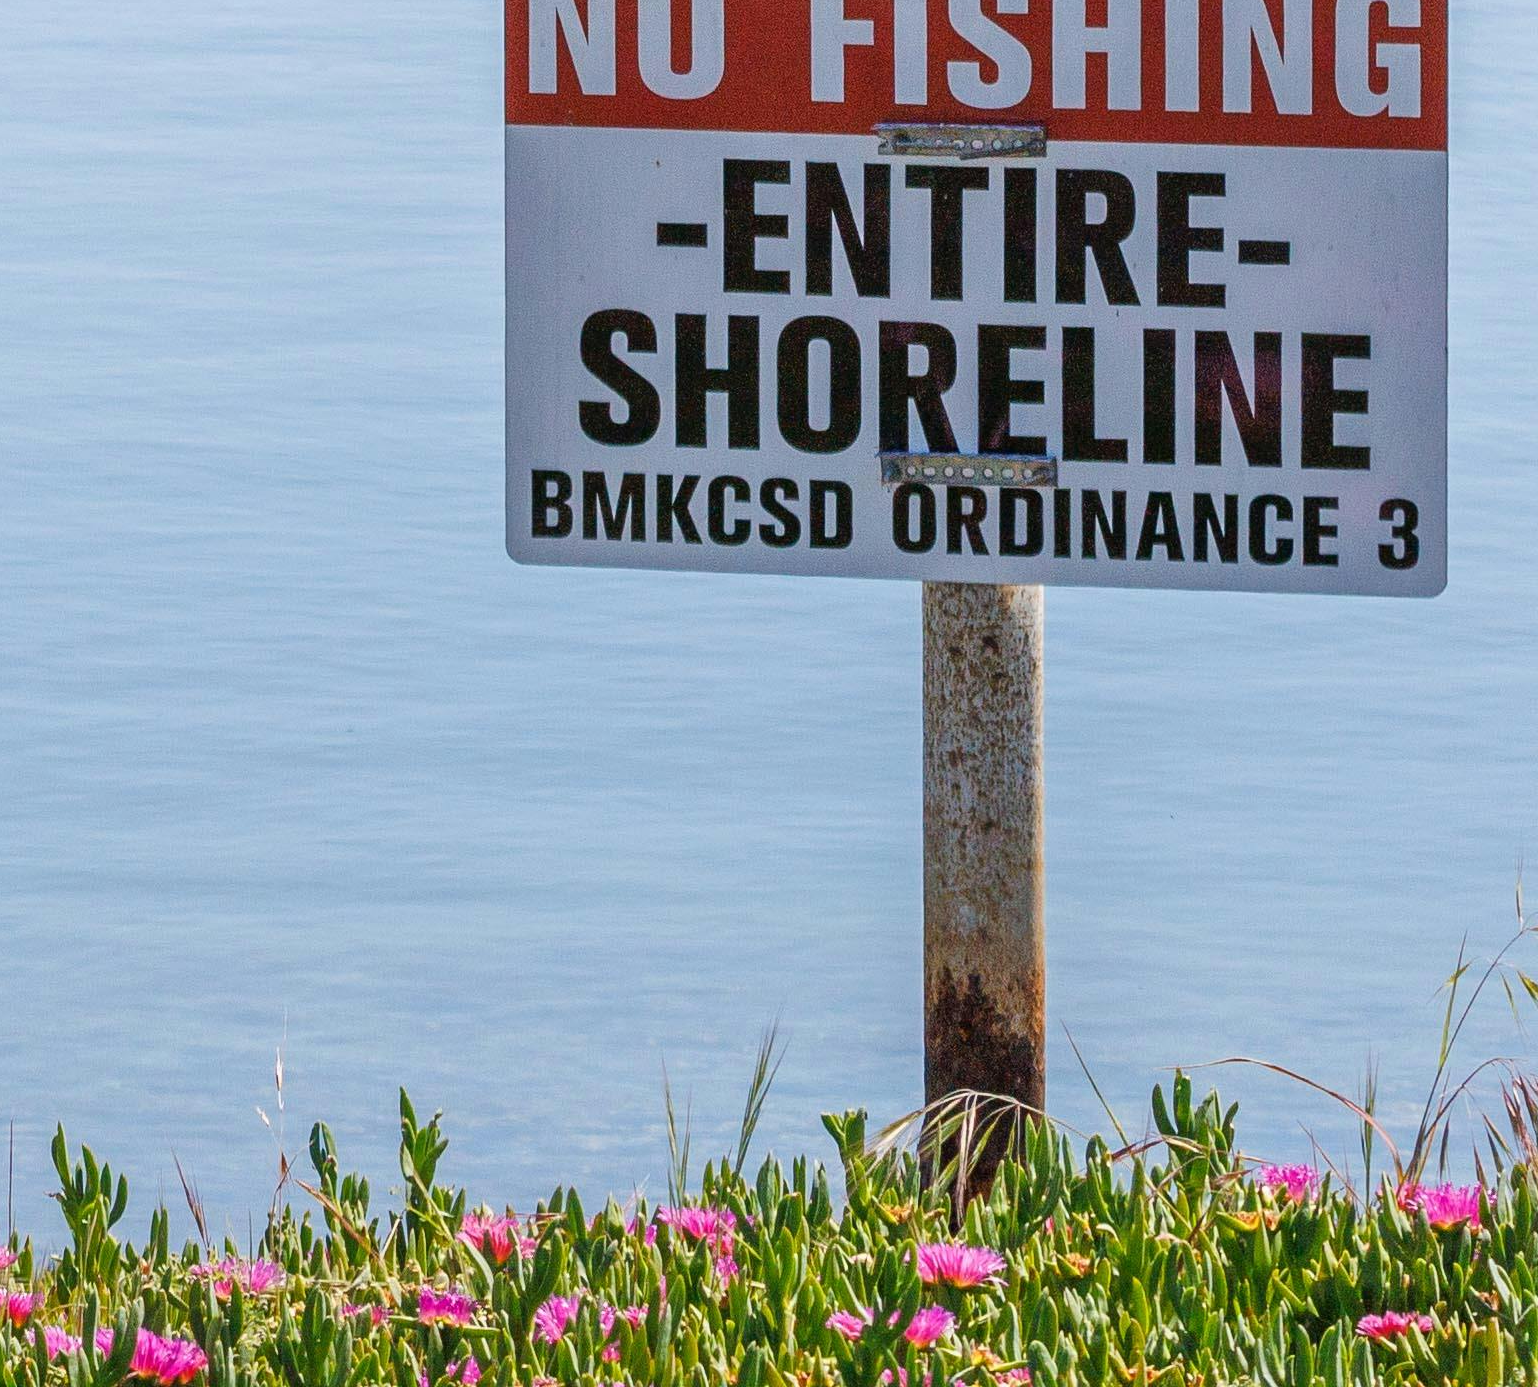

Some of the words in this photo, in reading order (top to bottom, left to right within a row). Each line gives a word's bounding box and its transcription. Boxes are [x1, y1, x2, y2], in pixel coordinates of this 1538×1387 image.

[656, 158, 1291, 309] -ENTIRE-
[578, 308, 1372, 471] SHORELINE
[530, 469, 854, 550] BMKCSD
[891, 483, 1345, 568] ORDINANCE
[1377, 498, 1420, 571] 3
